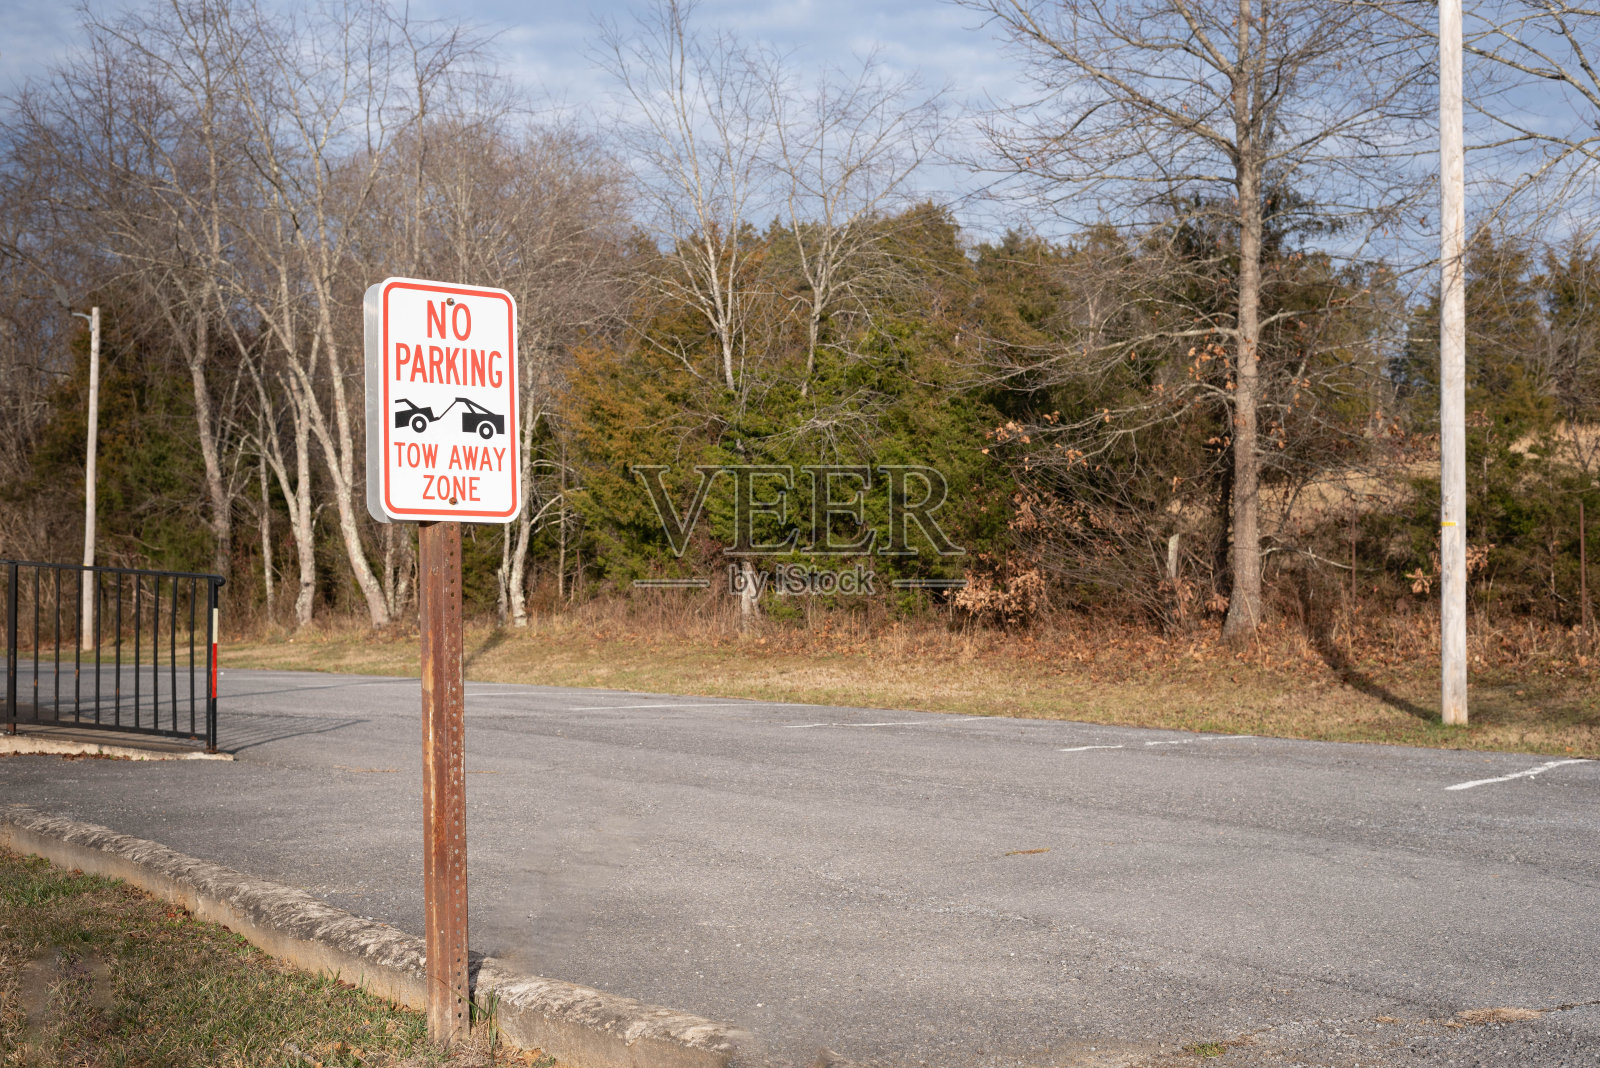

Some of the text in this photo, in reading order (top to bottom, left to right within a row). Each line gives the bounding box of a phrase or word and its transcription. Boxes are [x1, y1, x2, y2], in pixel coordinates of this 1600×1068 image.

[427, 300, 471, 341] NO
[396, 343, 502, 388] PARKING
[394, 442, 506, 472] TOW AWAY
[423, 475, 480, 502] ZONE
